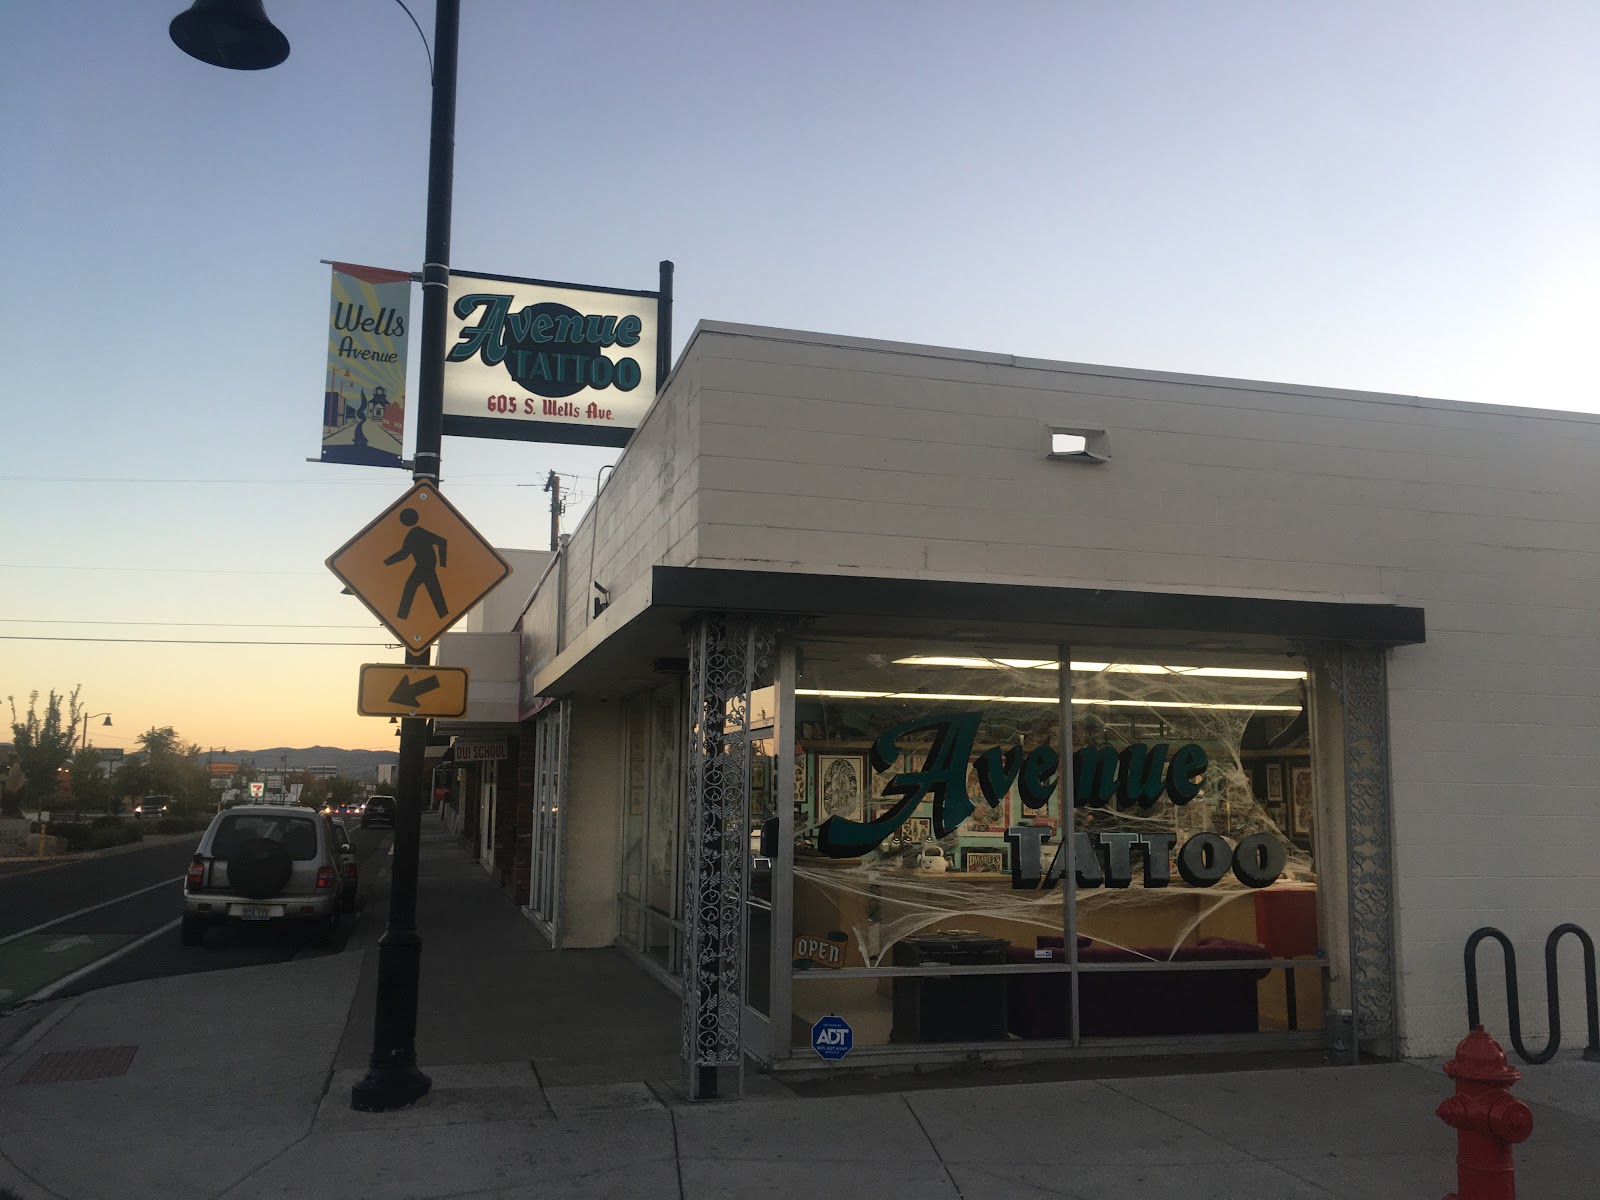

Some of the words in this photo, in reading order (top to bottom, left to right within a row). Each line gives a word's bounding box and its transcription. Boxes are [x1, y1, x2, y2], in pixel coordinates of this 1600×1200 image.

[334, 301, 405, 337] Wells
[445, 293, 642, 367] Avenue
[338, 335, 398, 363] Avenue
[511, 349, 641, 391] TATTOO
[487, 394, 517, 414] 605
[523, 398, 536, 415] S.
[541, 398, 580, 417] Wells
[585, 401, 615, 420] Ave.
[456, 746, 471, 759] DUI
[473, 744, 506, 758] SCHOOL
[817, 711, 1209, 858] Avenue
[1003, 825, 1288, 889] TATTOO
[797, 938, 839, 962] OPEN
[815, 1028, 849, 1046] ADT
